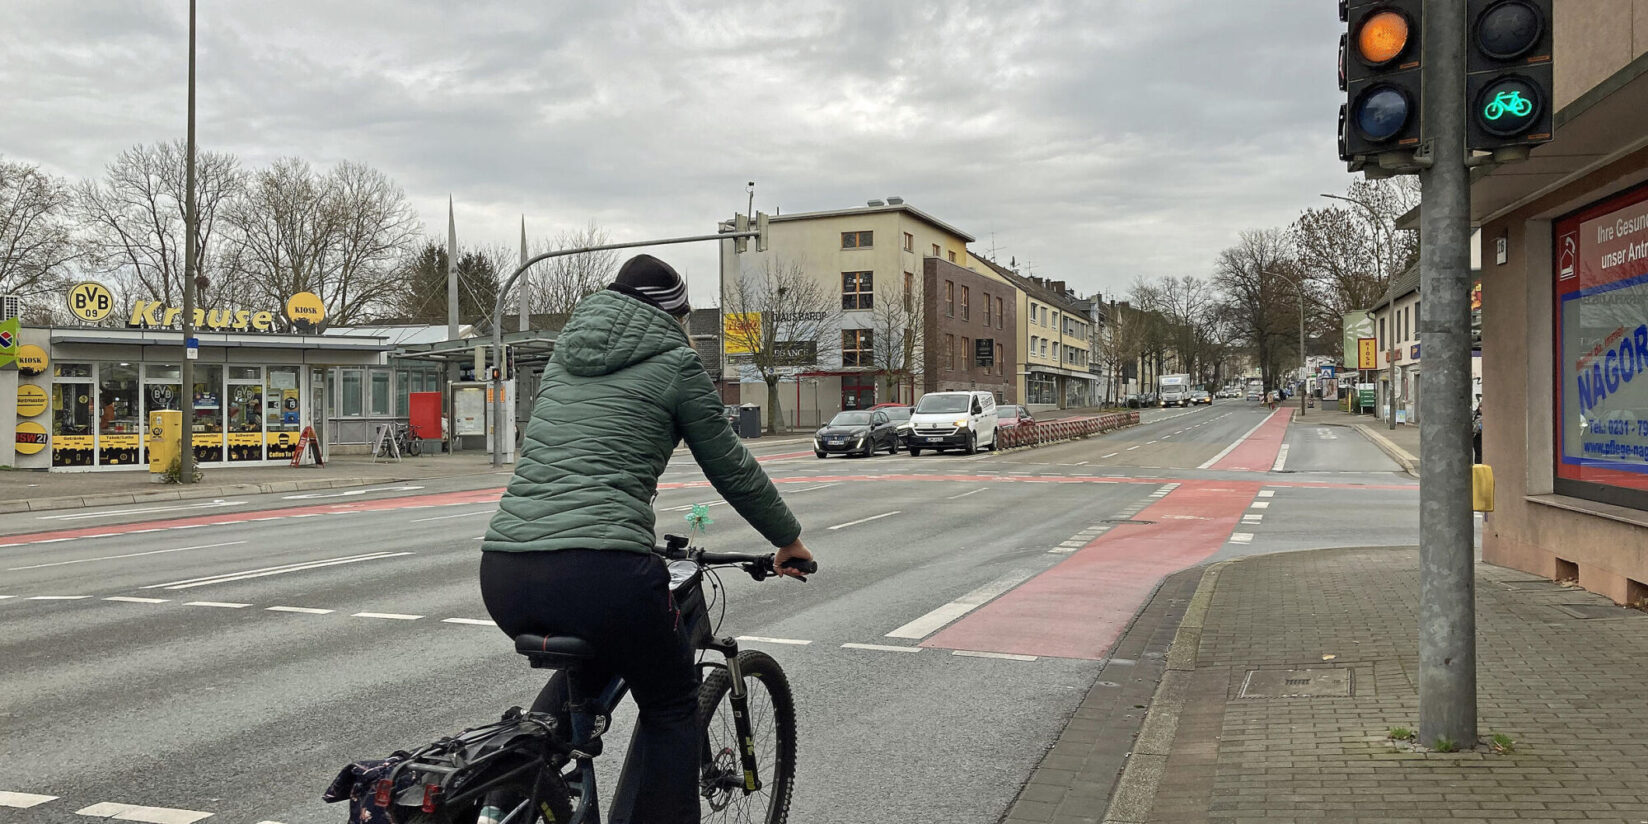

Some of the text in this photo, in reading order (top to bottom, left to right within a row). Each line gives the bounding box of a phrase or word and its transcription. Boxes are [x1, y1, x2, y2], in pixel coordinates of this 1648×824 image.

[1597, 225, 1614, 244] Ihre
[1601, 249, 1627, 269] unser
[75, 286, 109, 310] BVB
[85, 309, 98, 318] 09
[129, 300, 273, 330] Krause
[294, 306, 317, 314] KIOSK
[154, 385, 171, 399] BVB
[1608, 419, 1629, 435] 0231
